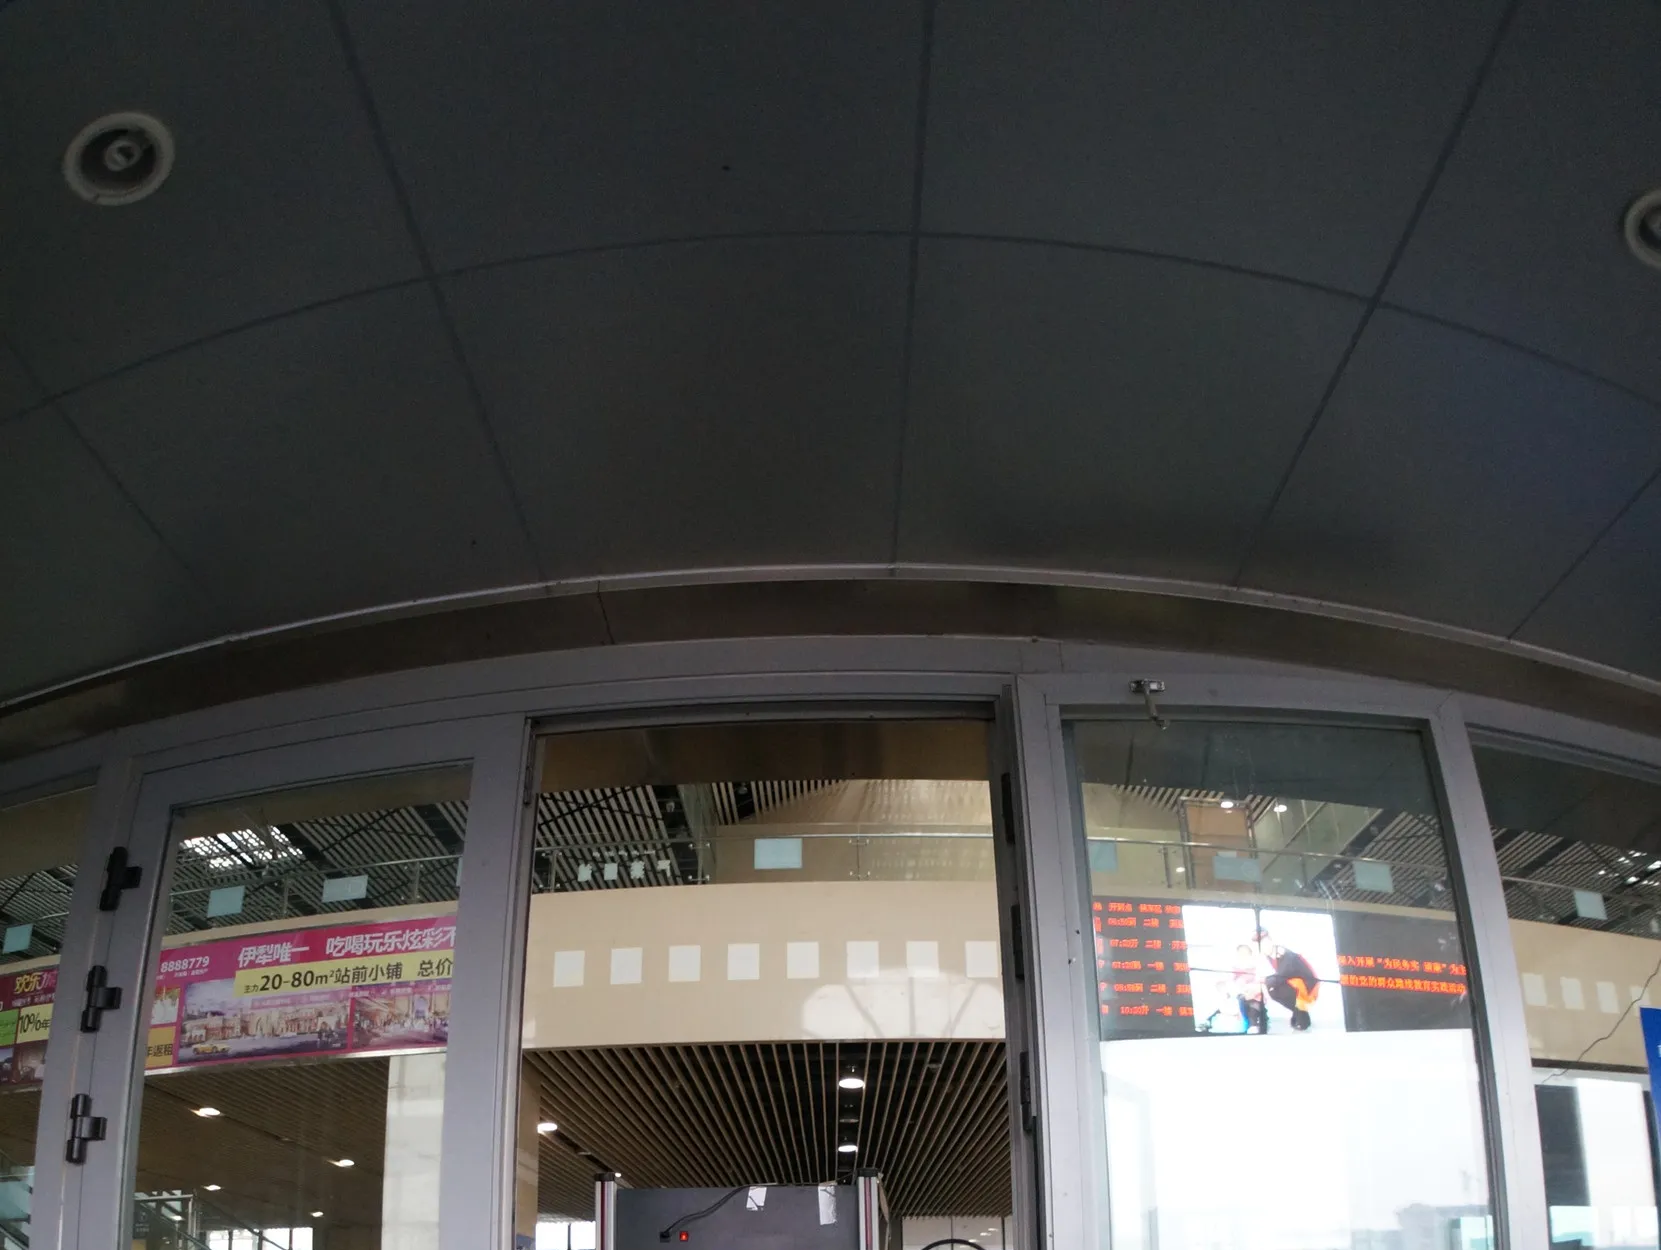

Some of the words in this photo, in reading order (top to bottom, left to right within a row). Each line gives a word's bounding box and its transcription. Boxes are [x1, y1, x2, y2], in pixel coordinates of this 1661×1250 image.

[160, 955, 210, 973] 8888779
[237, 942, 310, 968] 伊犁唯一
[417, 957, 454, 977] 总价
